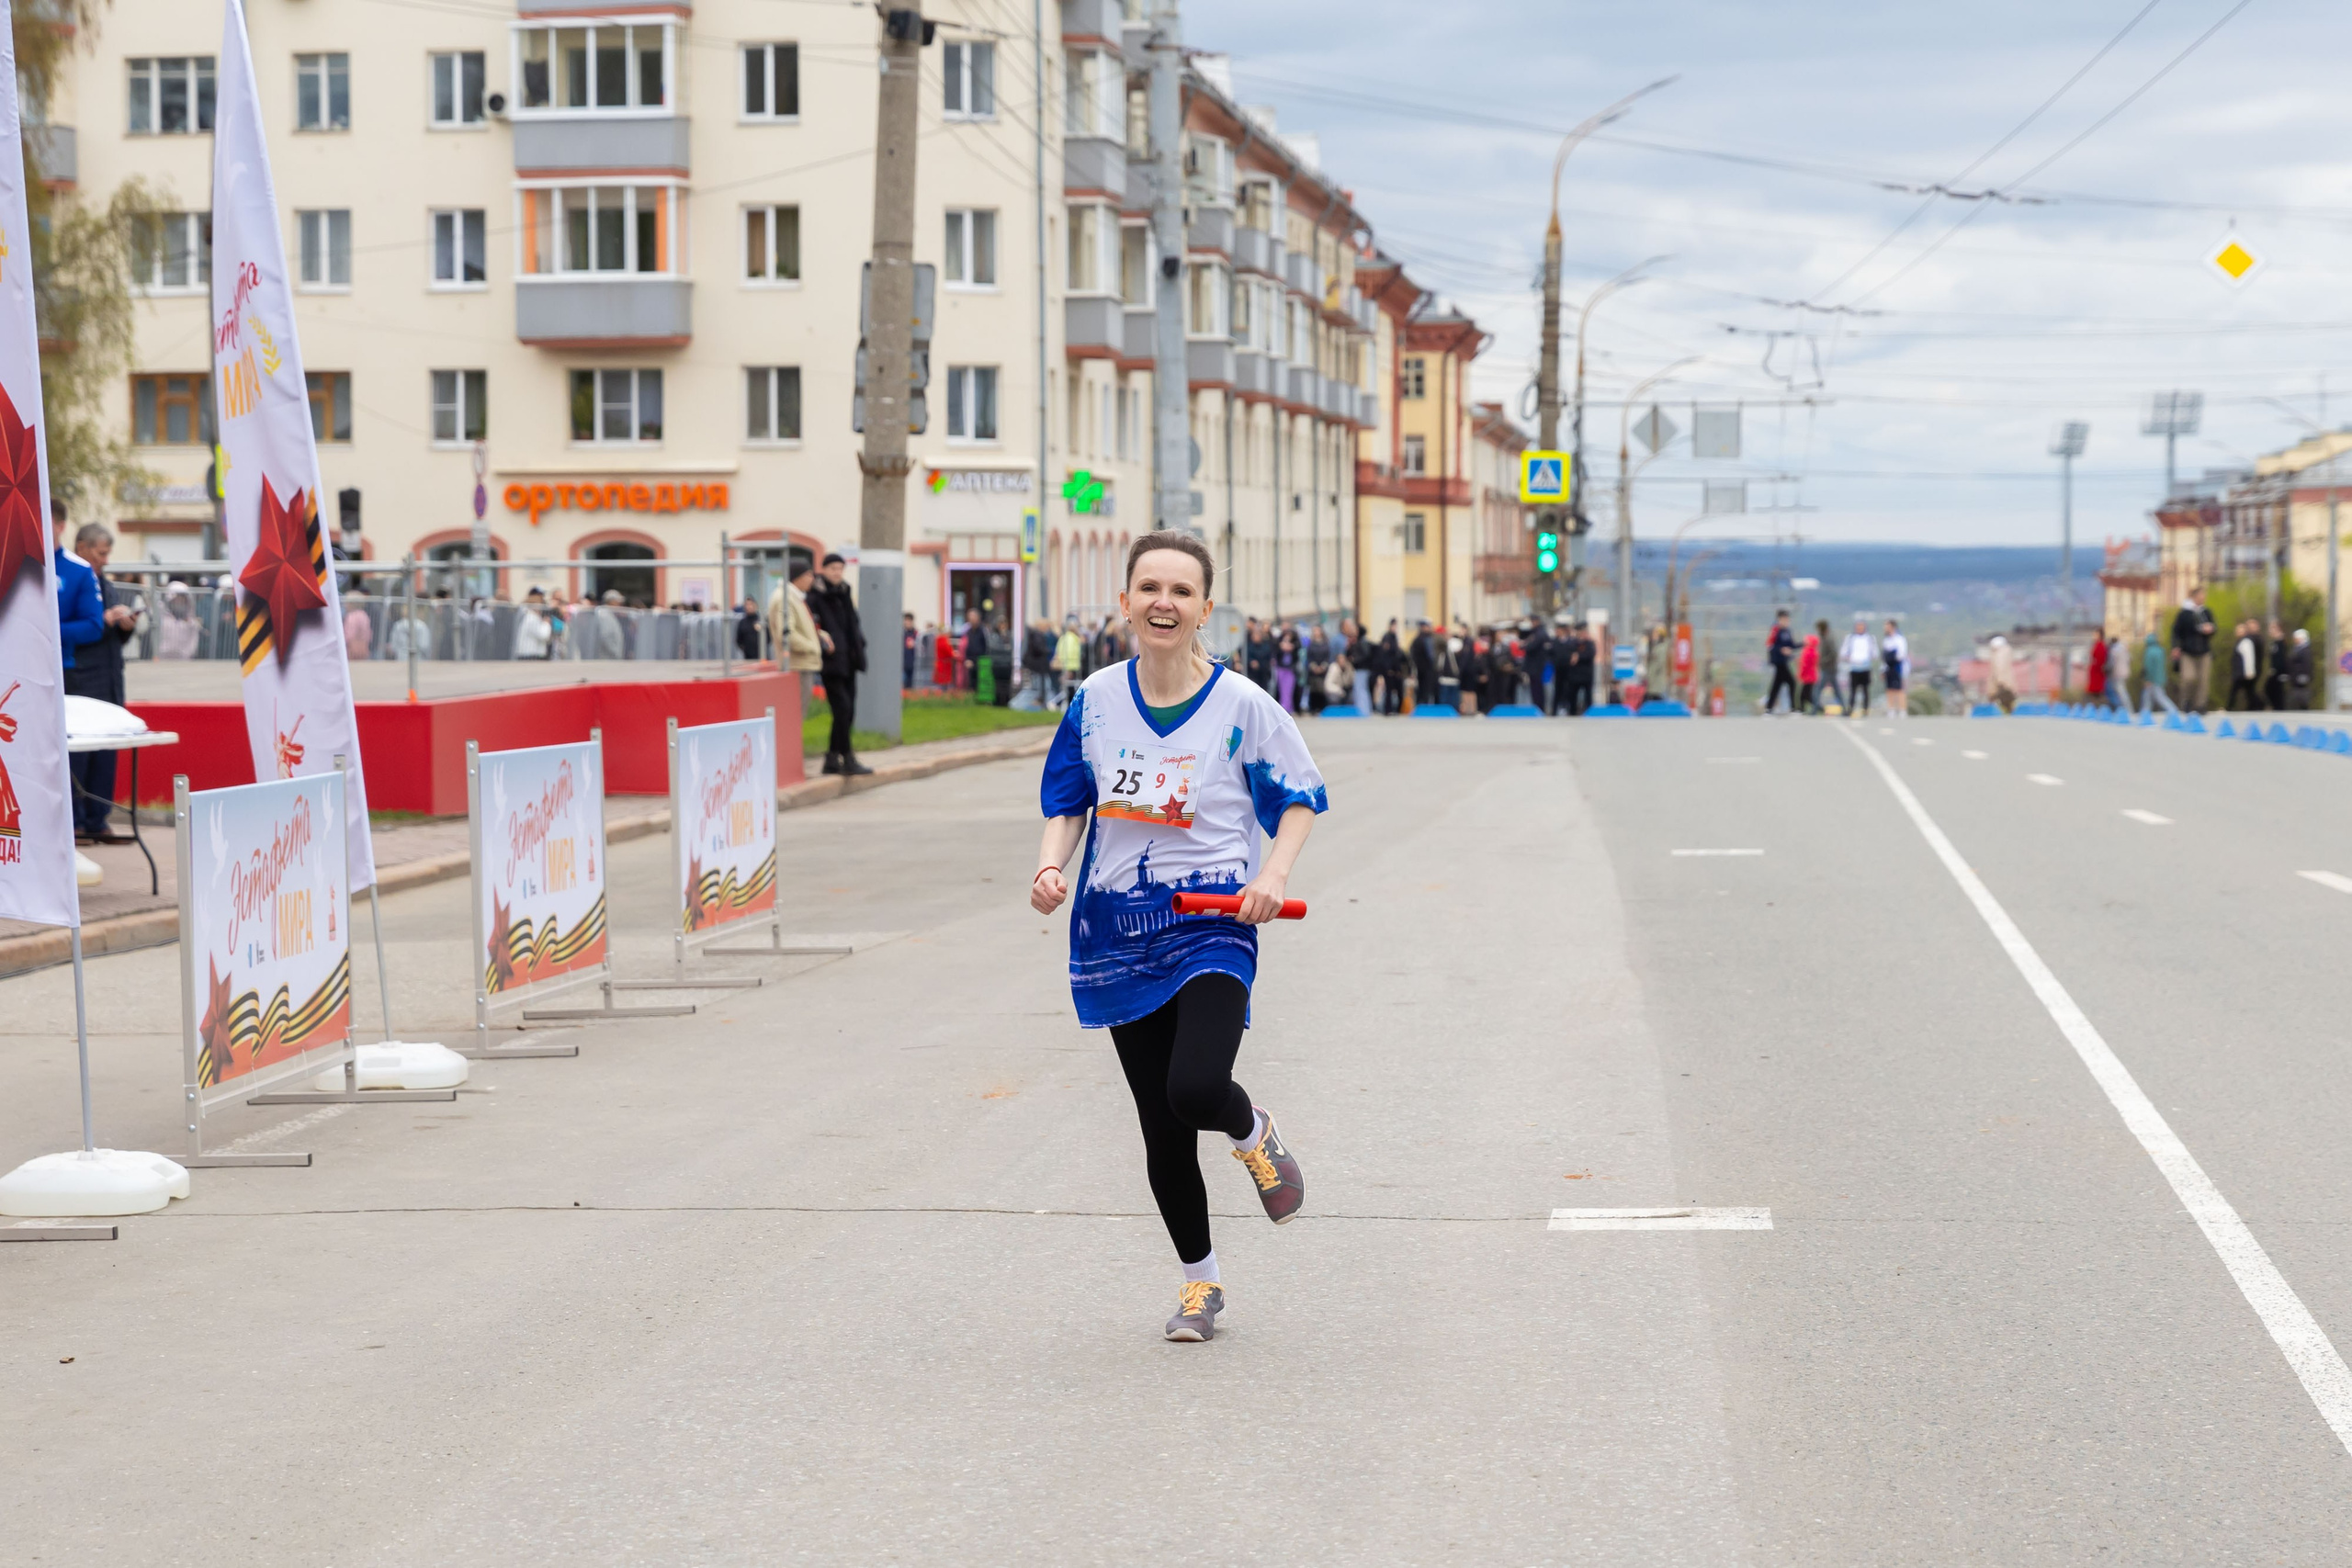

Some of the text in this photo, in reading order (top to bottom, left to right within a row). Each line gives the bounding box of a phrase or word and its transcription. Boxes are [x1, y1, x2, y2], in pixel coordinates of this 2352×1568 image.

[503, 480, 729, 526] ортопедия
[950, 472, 1032, 492] АПТЕКА
[1112, 769, 1166, 795] 25 9
[229, 794, 311, 962] Эстафета
[278, 888, 314, 959] МИРА
